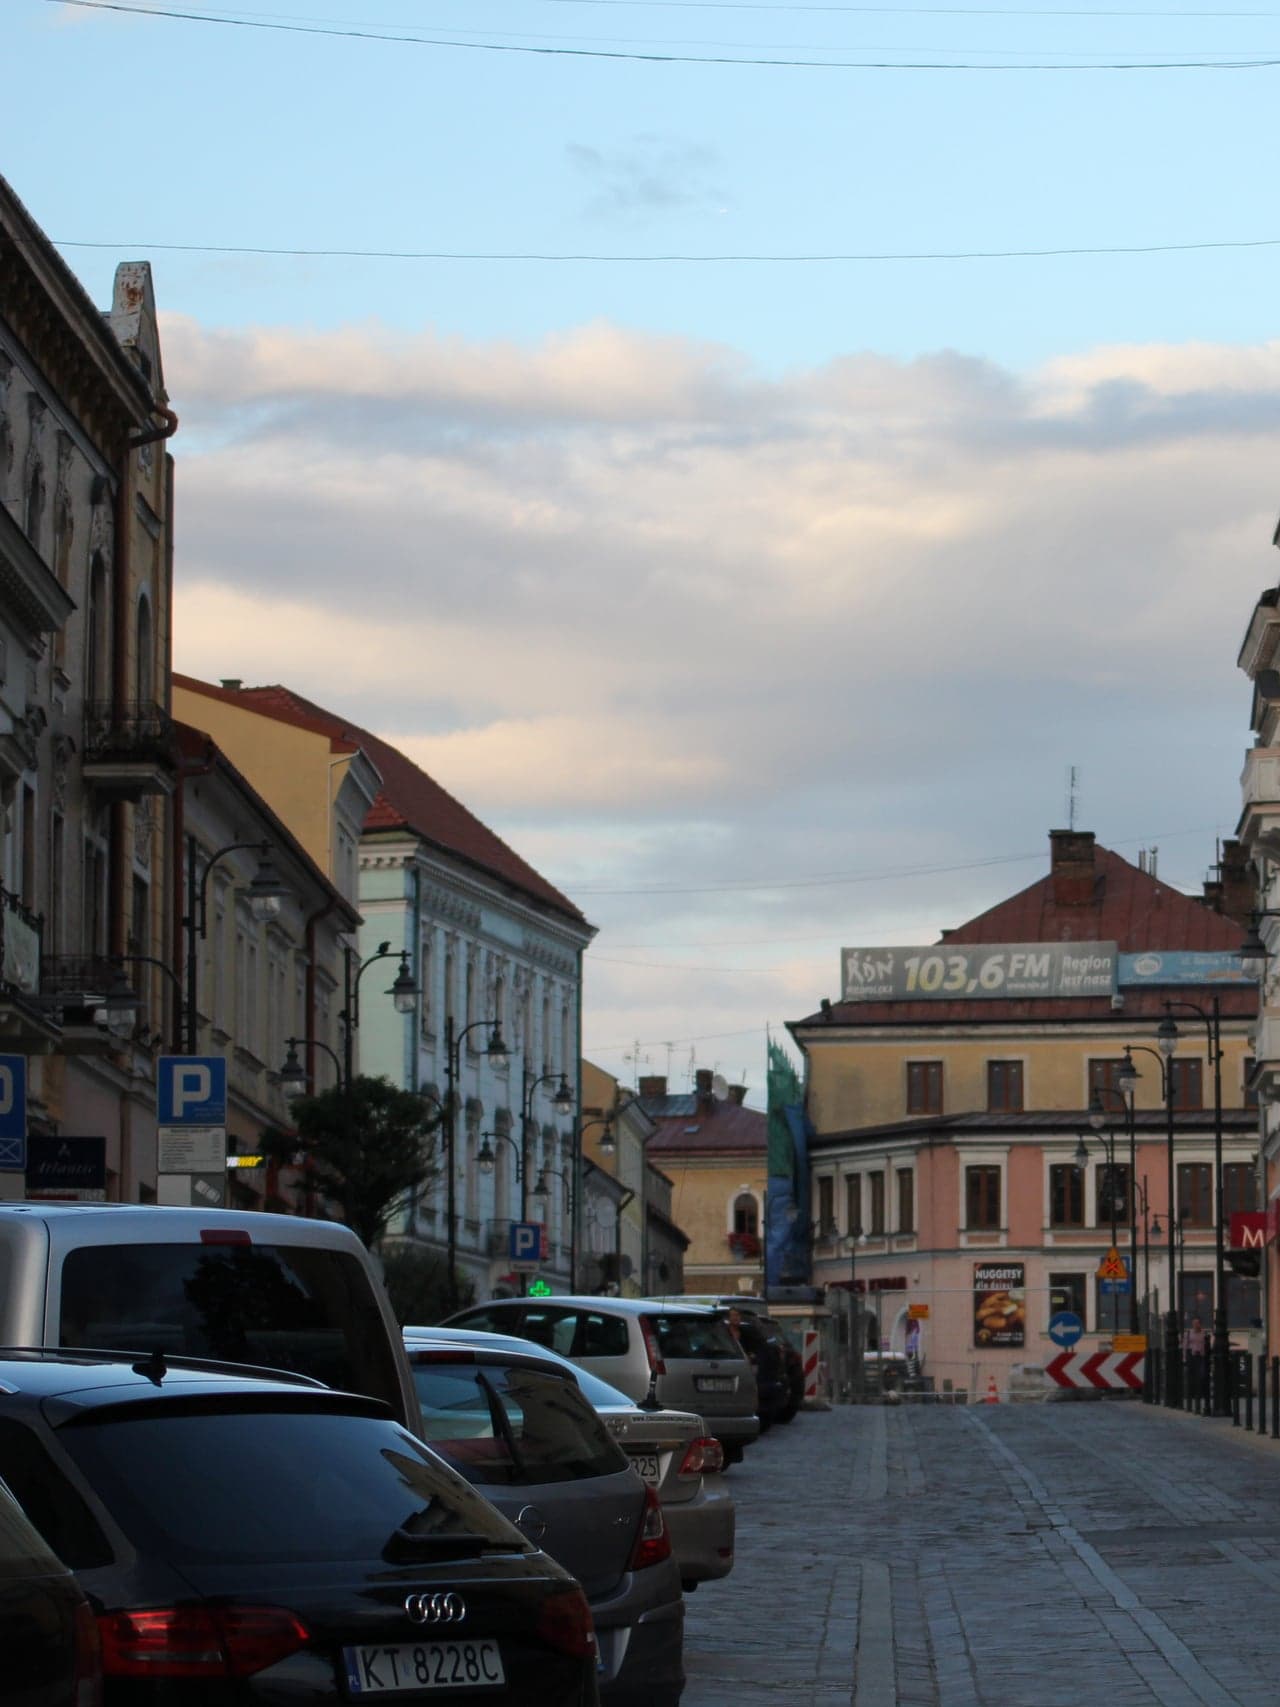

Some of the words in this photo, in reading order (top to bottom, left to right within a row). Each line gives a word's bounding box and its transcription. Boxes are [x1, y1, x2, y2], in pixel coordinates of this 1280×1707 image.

[904, 953, 1006, 993] 103,6
[1008, 952, 1050, 978] FM
[1062, 955, 1112, 971] Region
[1084, 974, 1112, 985] nasz
[171, 1063, 212, 1118] P
[515, 1227, 535, 1257] P
[1240, 1224, 1266, 1248] M
[975, 1268, 1022, 1279] NUGGETSY
[361, 1648, 400, 1689] KT
[412, 1643, 498, 1684] 8228C
